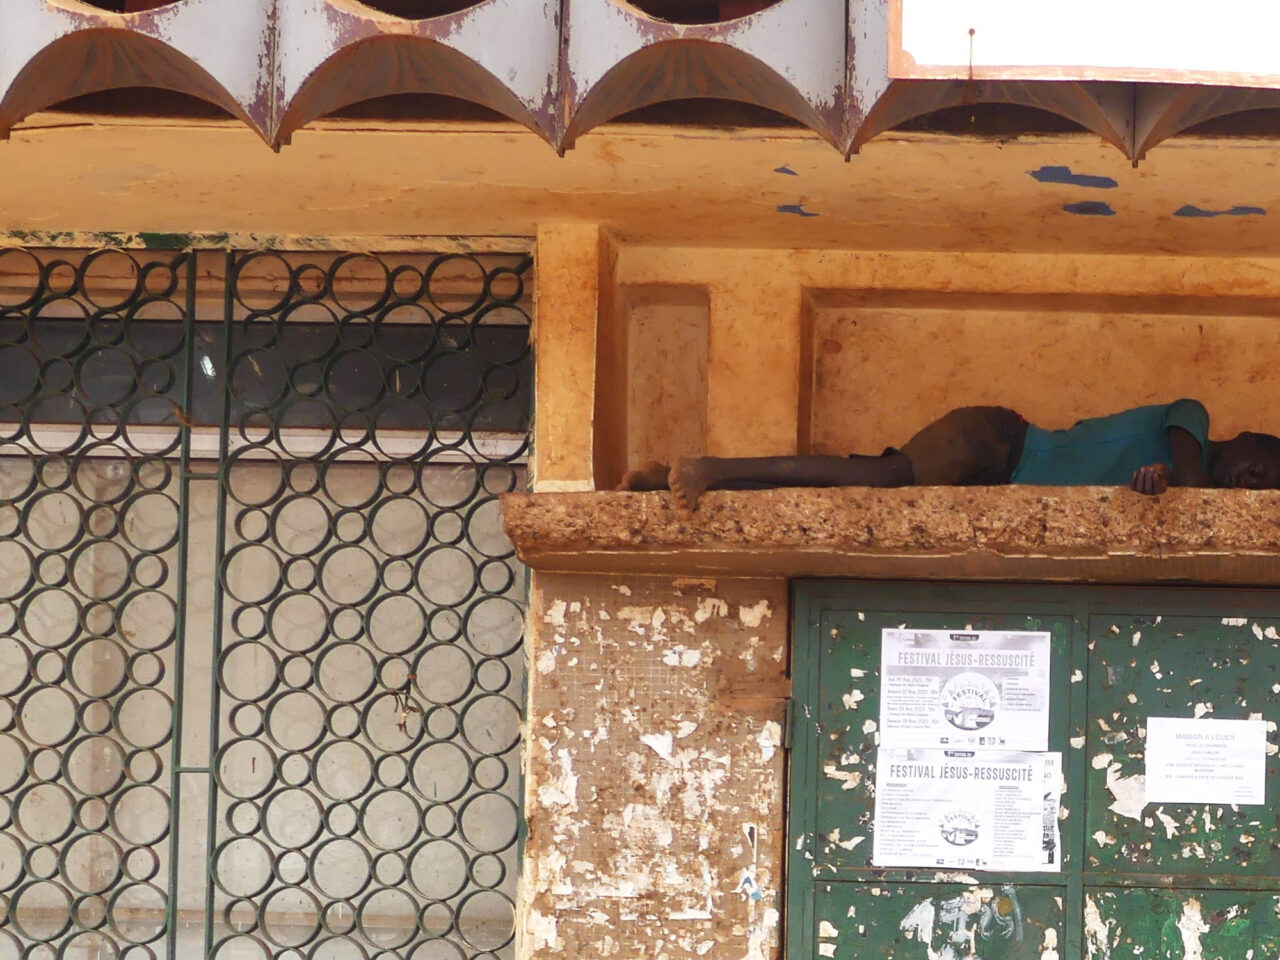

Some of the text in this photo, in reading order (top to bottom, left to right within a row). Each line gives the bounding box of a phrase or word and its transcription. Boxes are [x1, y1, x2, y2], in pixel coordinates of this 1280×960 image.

[898, 650, 1035, 668] FESTIVAL JÉSUS-RESSUSCITÉ
[952, 688, 988, 703] FESTIVAL
[890, 764, 936, 779] FESTIVAL
[939, 762, 1033, 782] JÉSUS-RESSUSCITÉ
